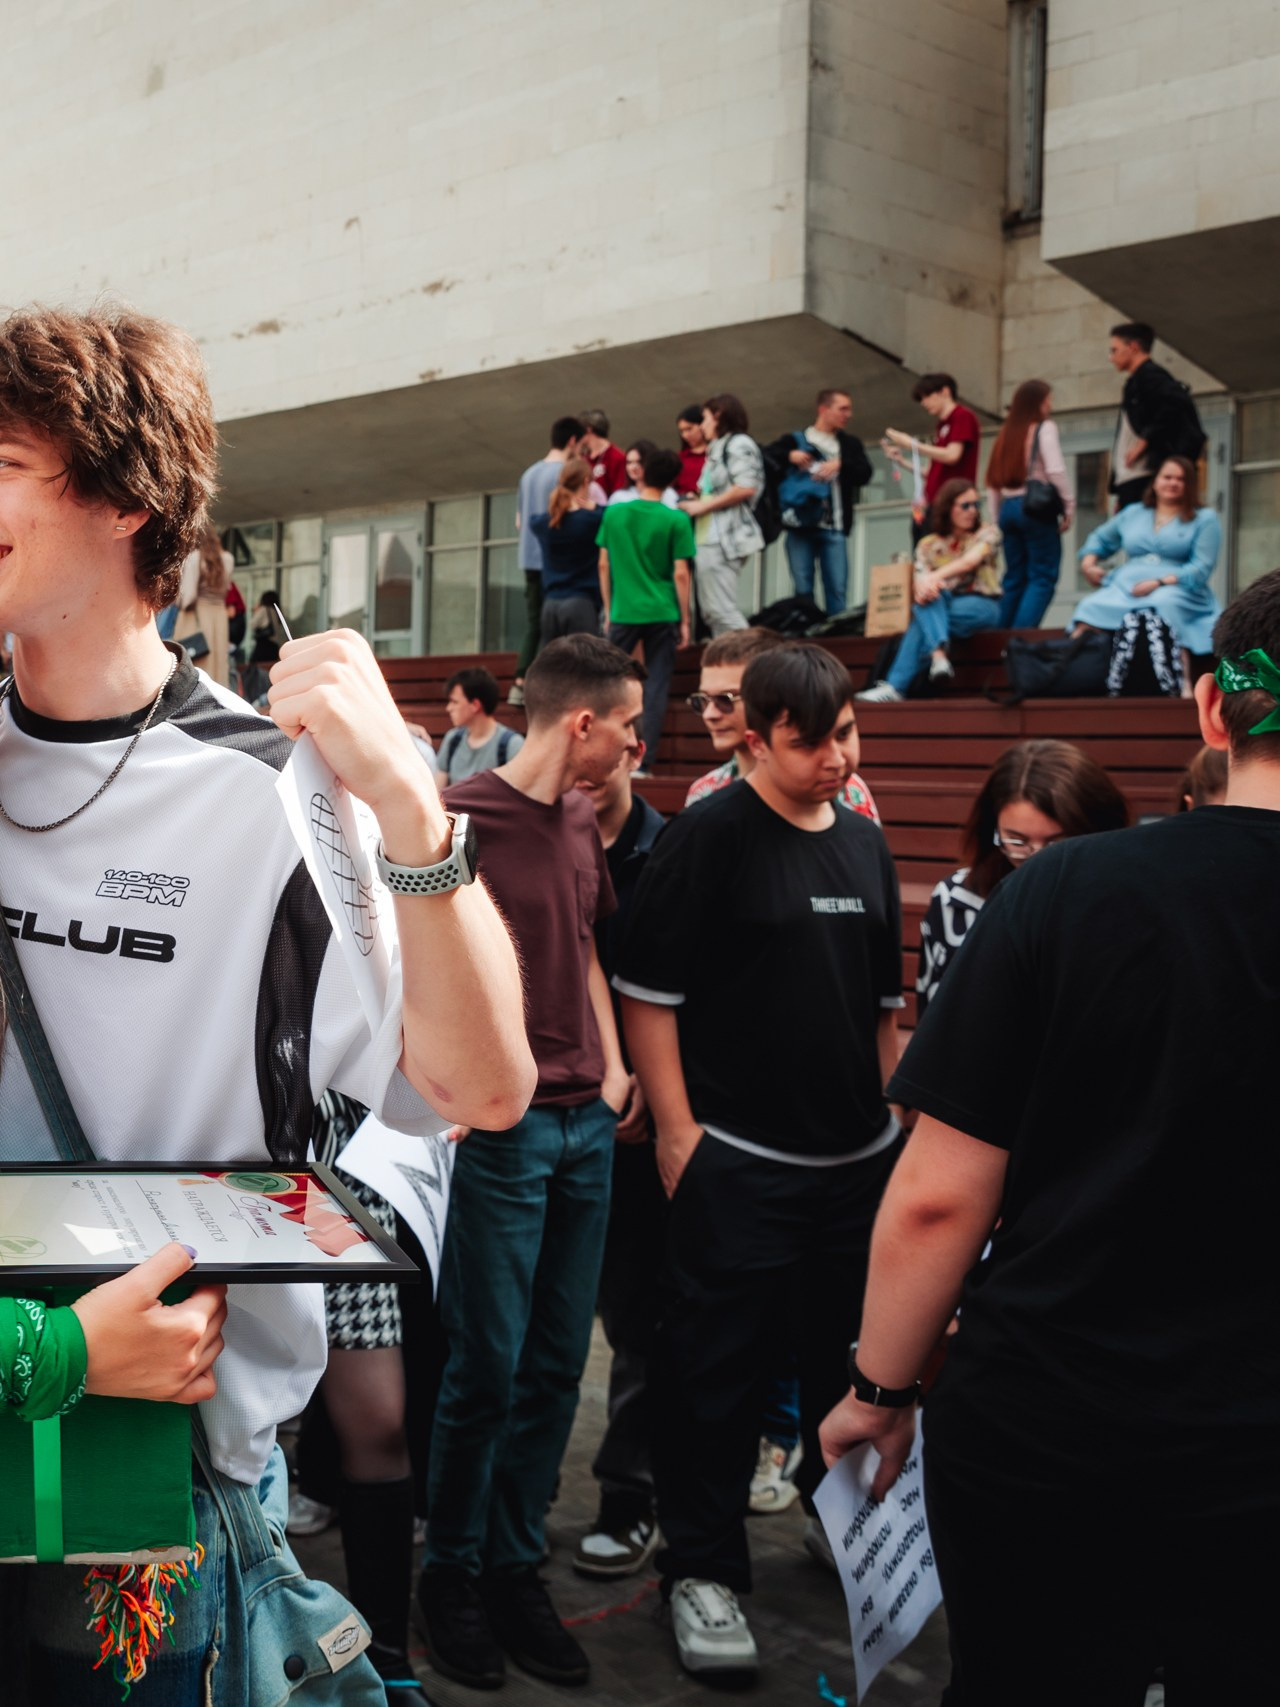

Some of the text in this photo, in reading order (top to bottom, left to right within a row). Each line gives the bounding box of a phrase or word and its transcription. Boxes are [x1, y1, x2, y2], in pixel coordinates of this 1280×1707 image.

[104, 869, 190, 889] 140-160
[95, 881, 186, 908] BPM
[182, 1190, 229, 1242] НАГРАЖДАЕТСЯ
[900, 1486, 920, 1512] нас
[860, 1594, 875, 1621] вы
[863, 1548, 934, 1653] Вы оказали нам
